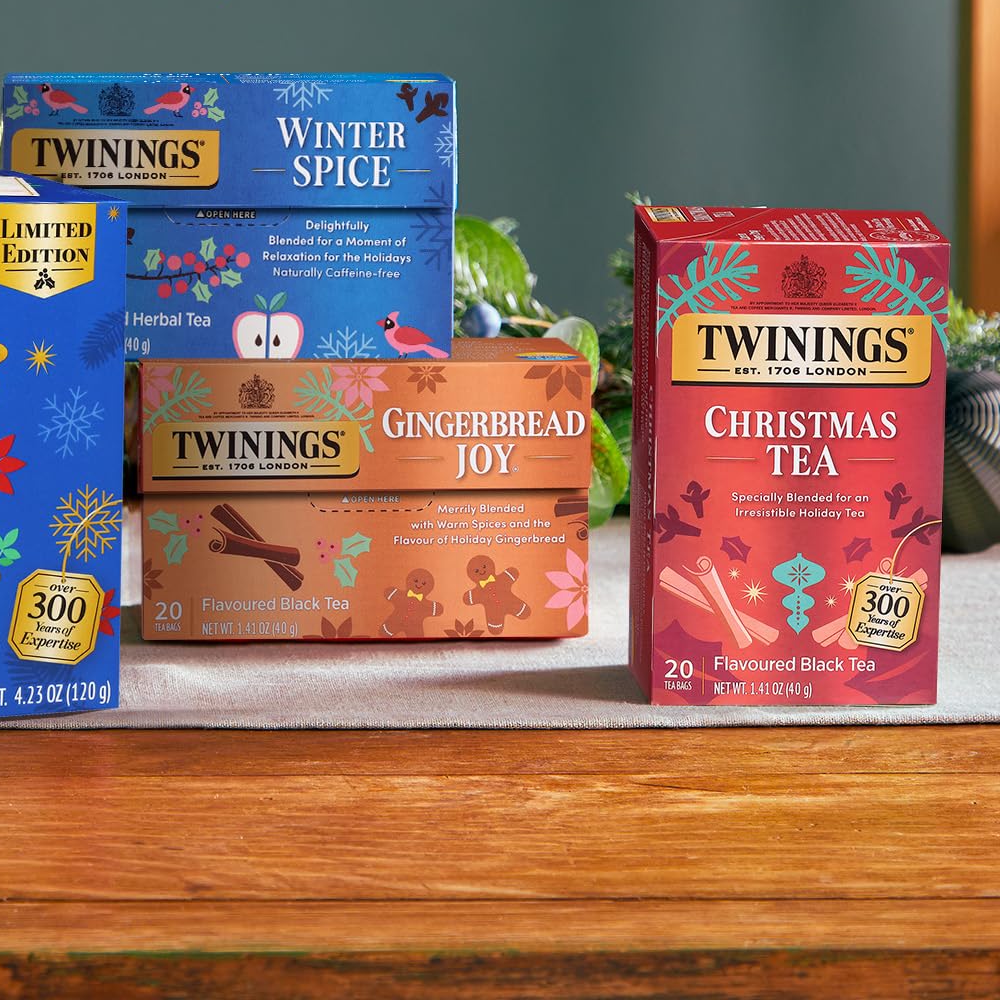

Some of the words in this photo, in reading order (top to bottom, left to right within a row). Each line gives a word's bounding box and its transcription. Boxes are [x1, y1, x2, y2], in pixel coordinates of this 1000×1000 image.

[276, 117, 406, 149] WINTER
[61, 172, 82, 180] EST.
[88, 172, 114, 180] 1706
[118, 172, 167, 181] LONDON
[292, 155, 391, 187] SPICE
[206, 210, 230, 219] OPEN
[232, 210, 256, 219] HERE
[0, 218, 92, 239] LIMITED
[305, 220, 369, 233] Delightfully
[268, 235, 314, 246] Blended
[317, 236, 332, 246] for
[336, 239, 343, 247] a
[346, 237, 392, 247] Moment
[395, 237, 407, 247] of
[2, 243, 90, 264] EDITION
[263, 251, 321, 262] Relaxation
[324, 252, 340, 262] for
[343, 252, 360, 262] the
[364, 253, 412, 264] Holidays
[273, 267, 322, 279] Naturally
[326, 268, 401, 279] Caffeine-free
[133, 312, 182, 326] Herbal
[186, 312, 211, 327] Tea
[124, 337, 139, 354] (40
[141, 338, 151, 355] g)
[734, 367, 761, 375] EST.
[767, 366, 800, 375] 1706
[806, 367, 867, 376] LONDON
[382, 407, 586, 438] GINGERBREAD
[704, 405, 898, 439] CHRISTMAS
[229, 463, 255, 471] 1706
[765, 444, 840, 477] TEA
[351, 495, 375, 503] OPEN
[377, 495, 401, 503] HERE
[731, 492, 783, 504] Specially
[786, 493, 833, 503] Blended
[835, 493, 852, 503] for
[855, 494, 869, 503] an
[437, 504, 476, 515] Merrily
[479, 504, 525, 514] Blended
[735, 507, 796, 518] Irresistible
[799, 508, 842, 520] Holiday
[845, 508, 865, 518] Tea
[411, 520, 434, 530] with
[437, 520, 469, 529] Warm
[472, 519, 507, 531] Spices
[509, 519, 531, 528] and
[533, 519, 551, 528] the
[393, 535, 434, 546] Flavour
[437, 535, 449, 545] of
[451, 535, 492, 547] Holiday
[495, 534, 566, 547] Gingerbread
[49, 583, 77, 594] over
[879, 584, 902, 594] over
[27, 592, 87, 624] 300
[154, 601, 182, 621] 20
[202, 597, 276, 612] Flavoured
[280, 597, 320, 611] Black
[324, 597, 349, 610] Tea
[861, 590, 910, 618] 300
[35, 621, 63, 634] Years
[62, 625, 75, 637] of
[155, 623, 167, 632] TEA
[167, 623, 182, 632] BAGS
[202, 622, 218, 636] NET
[219, 622, 234, 636] WT.
[237, 622, 257, 636] 1.41
[259, 622, 271, 636] OZ
[272, 621, 287, 637] (40
[289, 622, 298, 637] g)
[867, 614, 889, 626] Years
[888, 619, 901, 629] of
[855, 621, 906, 641] Expertise
[20, 631, 82, 651] Expertise
[664, 659, 693, 679] 20
[714, 656, 796, 672] Flavoured
[801, 656, 844, 672] Black
[848, 657, 876, 672] Tea
[664, 681, 676, 690] TEA
[676, 681, 692, 690] BAGS
[714, 682, 731, 695] NET
[732, 682, 748, 695] WT.
[750, 682, 769, 695] 1.41
[772, 682, 783, 695] OZ
[785, 682, 801, 698] (40
[803, 683, 812, 699] g)
[14, 686, 43, 705] 4.23
[47, 684, 64, 703] OZ
[66, 681, 96, 707] (120
[99, 680, 111, 705] g)
